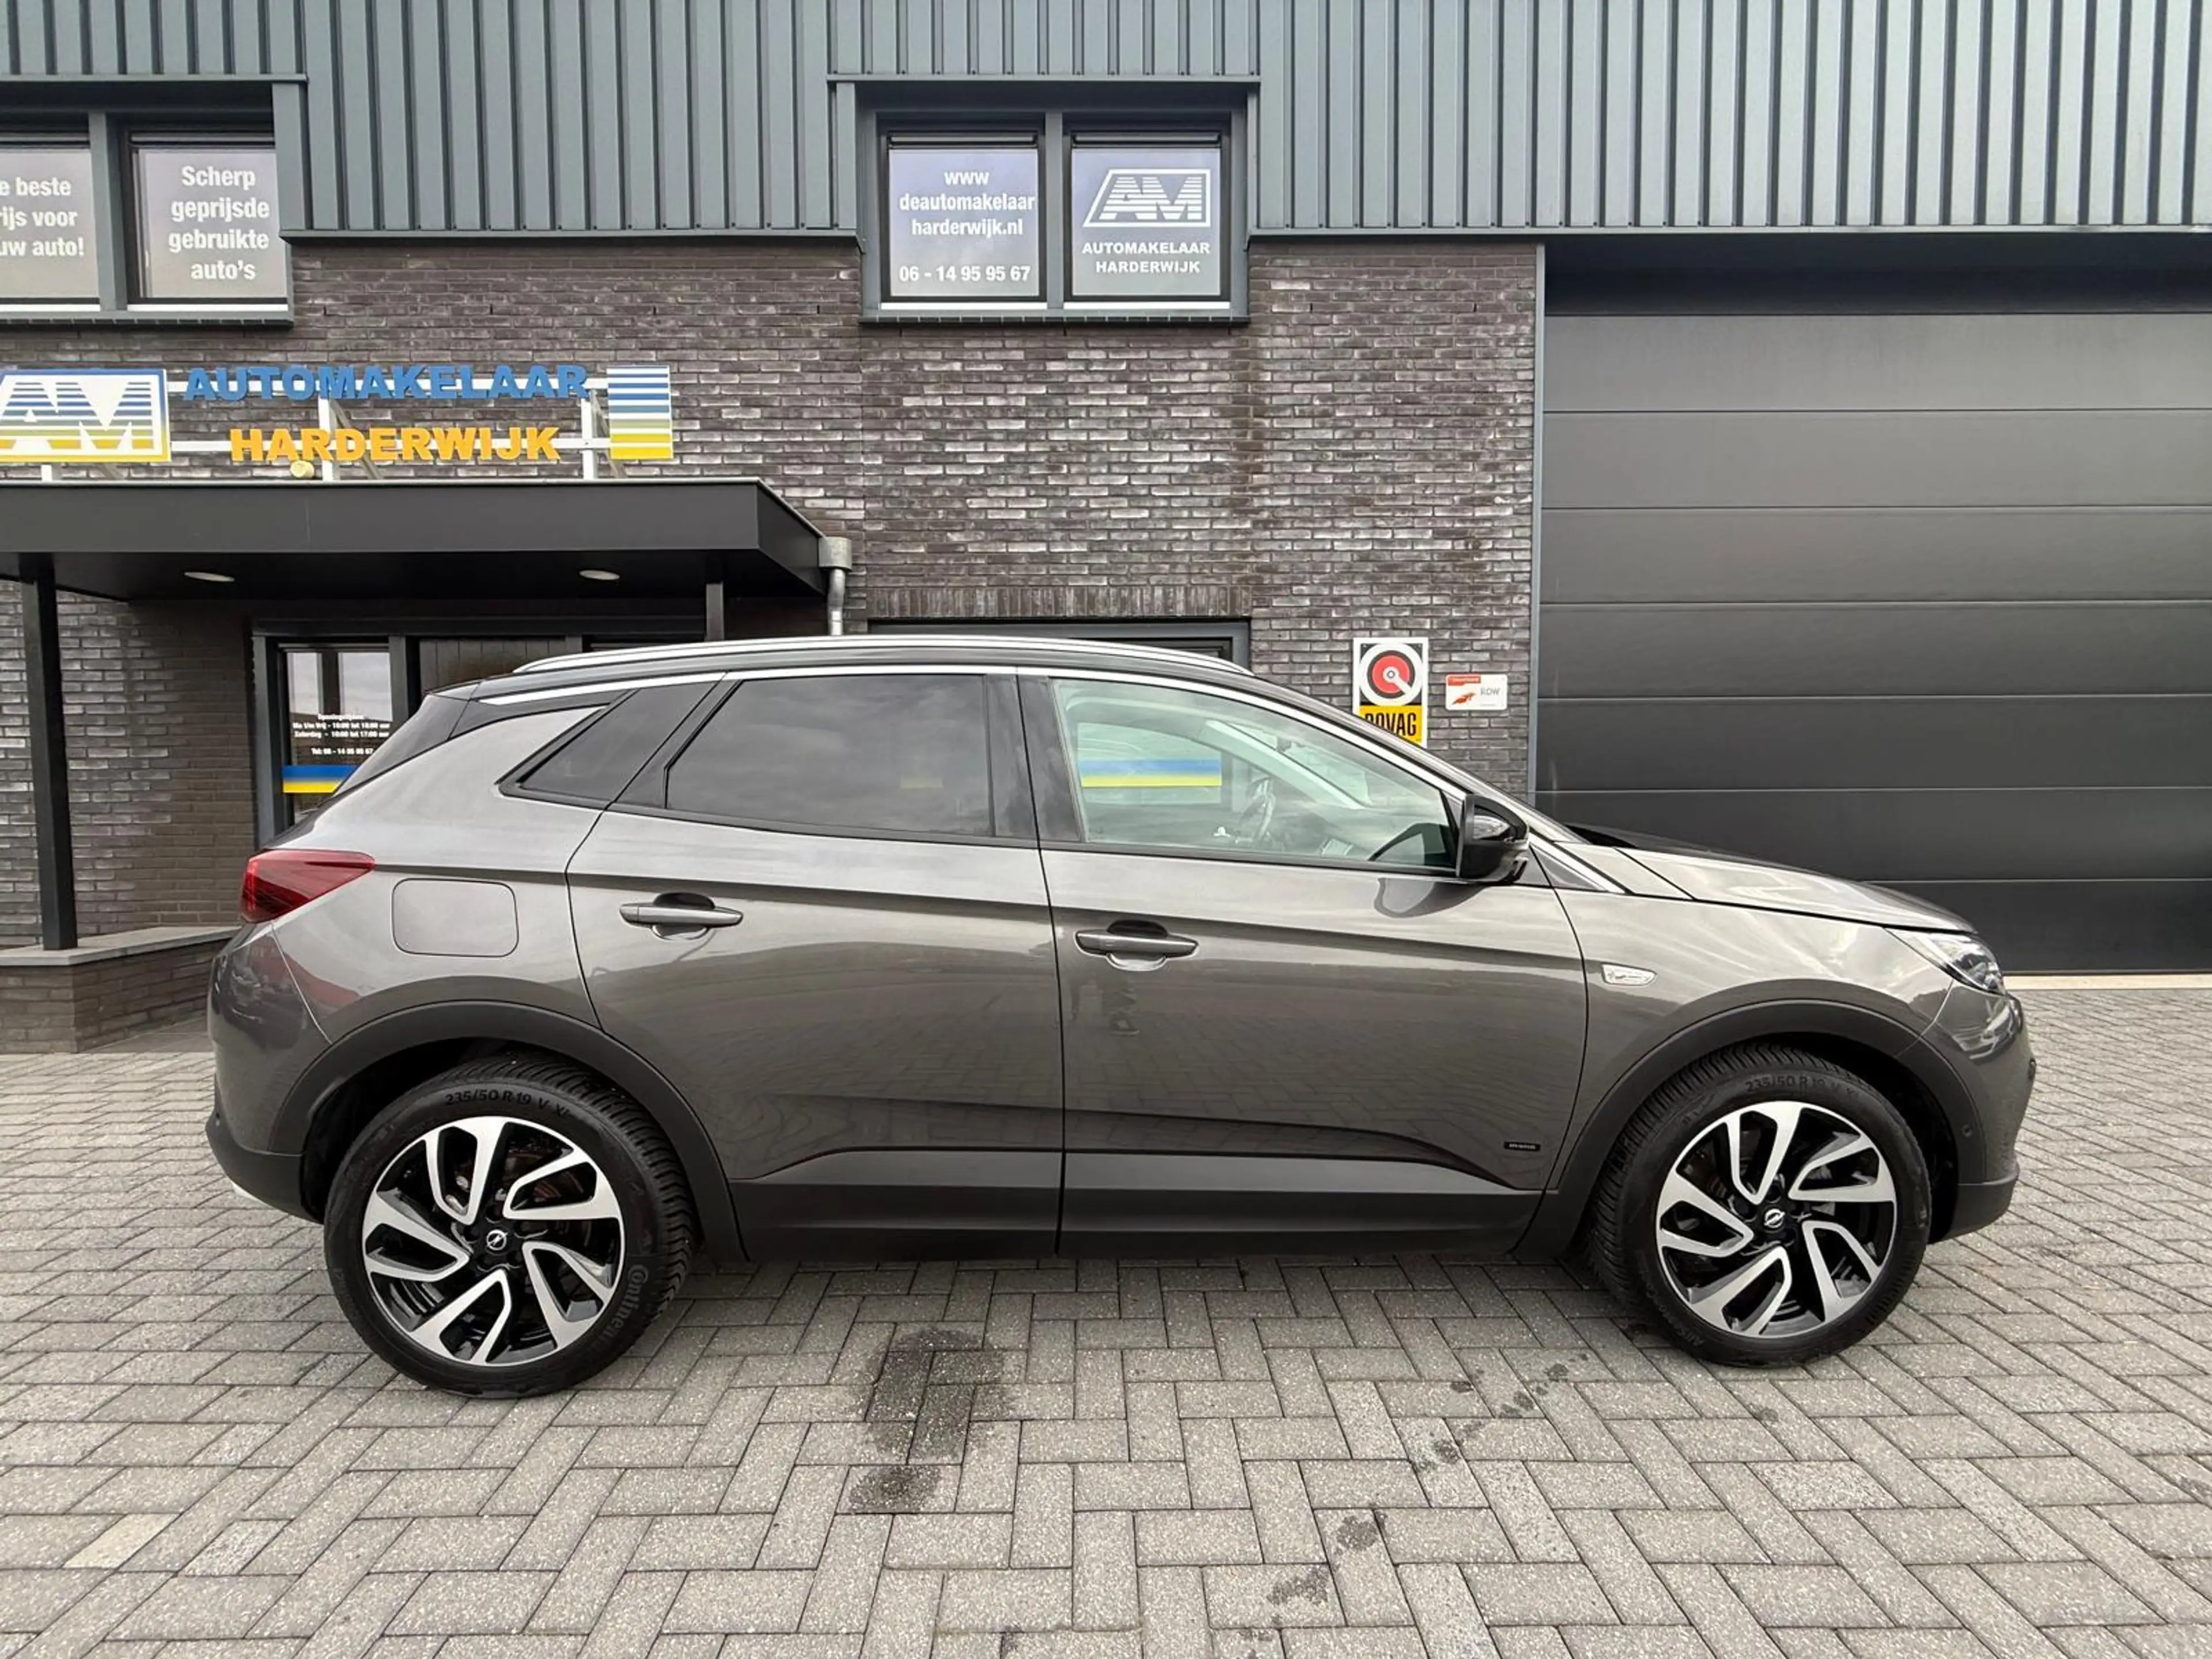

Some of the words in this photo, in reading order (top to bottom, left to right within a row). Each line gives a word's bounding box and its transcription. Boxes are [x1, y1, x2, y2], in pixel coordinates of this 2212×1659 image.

[15, 177, 71, 196] beste
[181, 166, 256, 191] Scherp
[944, 172, 990, 185] www
[899, 194, 1036, 211] deautomakelaar
[1099, 176, 1202, 220] AM
[171, 196, 270, 222] geprijsde
[32, 211, 78, 227] voor
[911, 219, 1023, 238] harderwijk.nl
[32, 237, 84, 257] auto!
[168, 229, 270, 253] gebruikte
[1082, 242, 1210, 255] AUTOMAKELAAR
[191, 260, 256, 280] auto's
[899, 266, 919, 282] 06
[935, 266, 956, 282] 14
[961, 266, 980, 282] 95
[986, 266, 1005, 282] 95
[1010, 266, 1031, 282] 67
[1096, 261, 1200, 274] HARDERWIJK
[184, 365, 590, 400] AUTOMAKELAAR
[0, 381, 154, 449] AM
[230, 426, 561, 462] HARDERWIJK
[445, 1089, 498, 1105] 235/50
